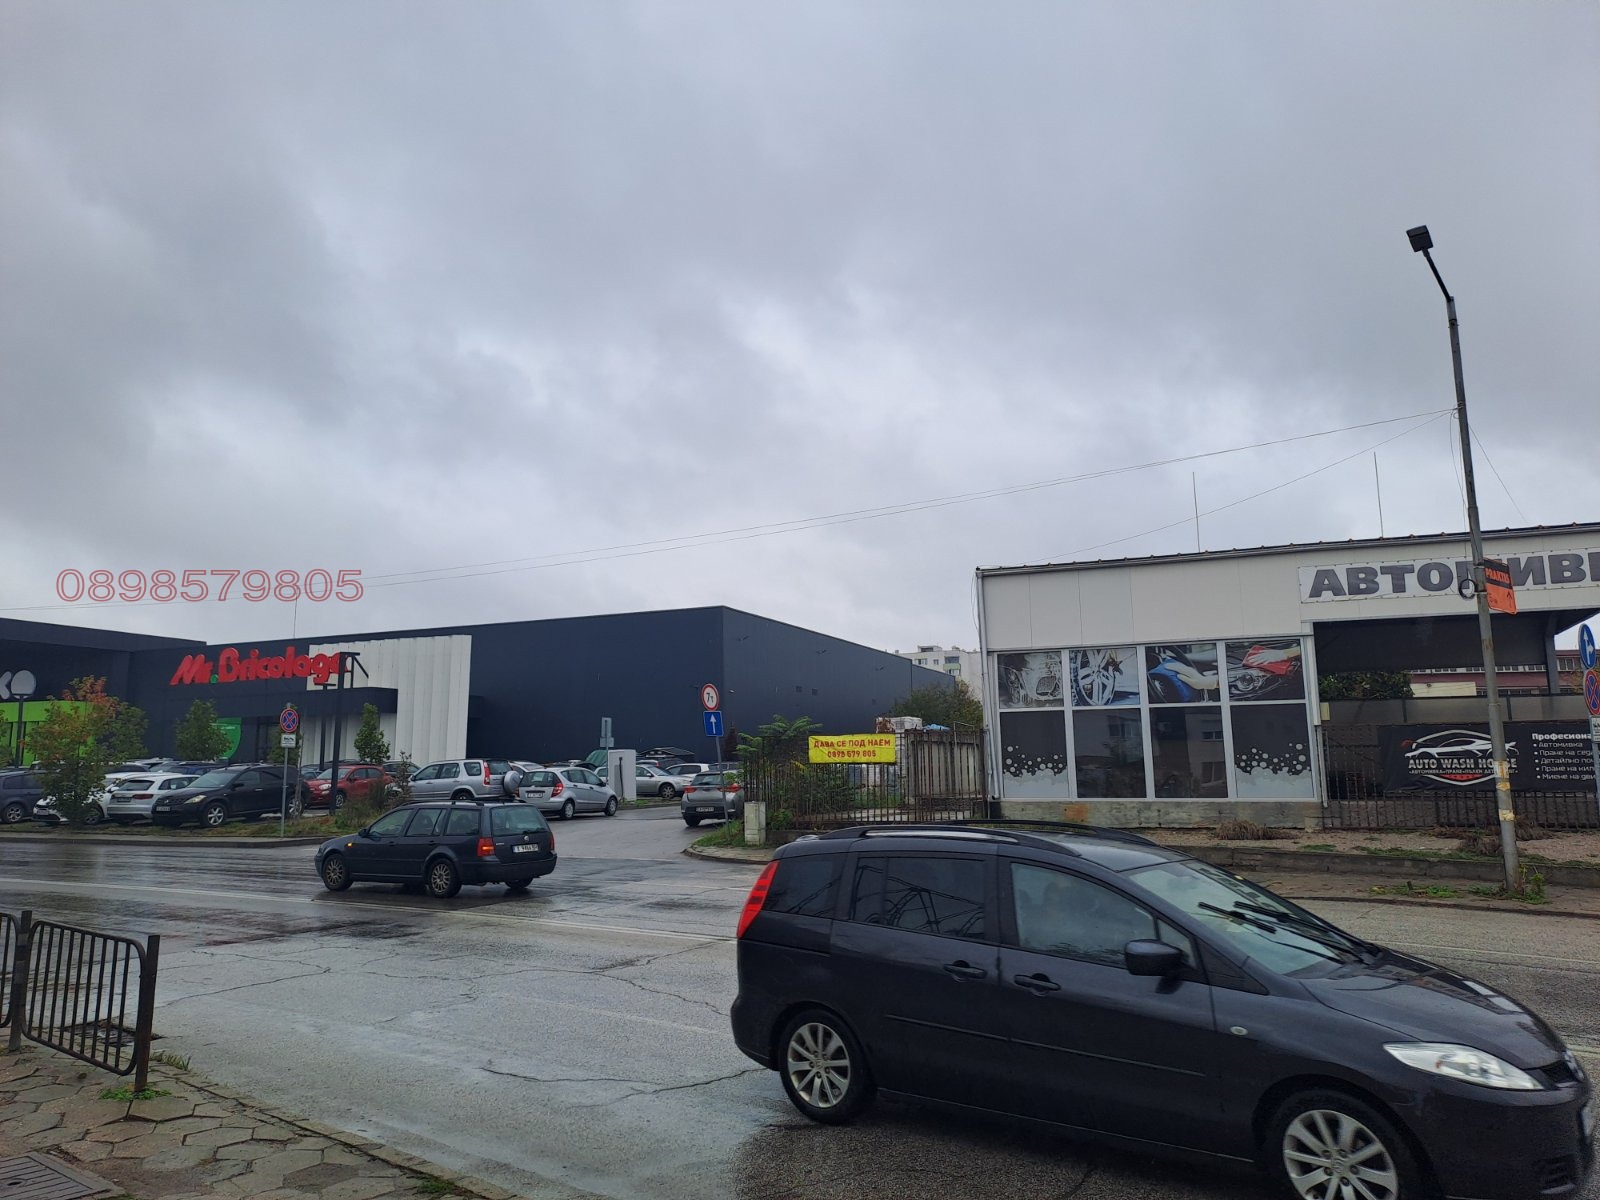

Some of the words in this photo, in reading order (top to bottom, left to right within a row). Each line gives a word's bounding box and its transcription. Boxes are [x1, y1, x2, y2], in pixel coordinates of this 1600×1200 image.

[1308, 552, 1600, 598] АВТОИВ
[814, 740, 835, 749] ДАВА
[836, 740, 847, 748] СЕ
[848, 739, 866, 748] ПОД
[1408, 759, 1437, 769] AUTO
[1441, 758, 1474, 769] WASH
[1478, 758, 1517, 768] HOE
